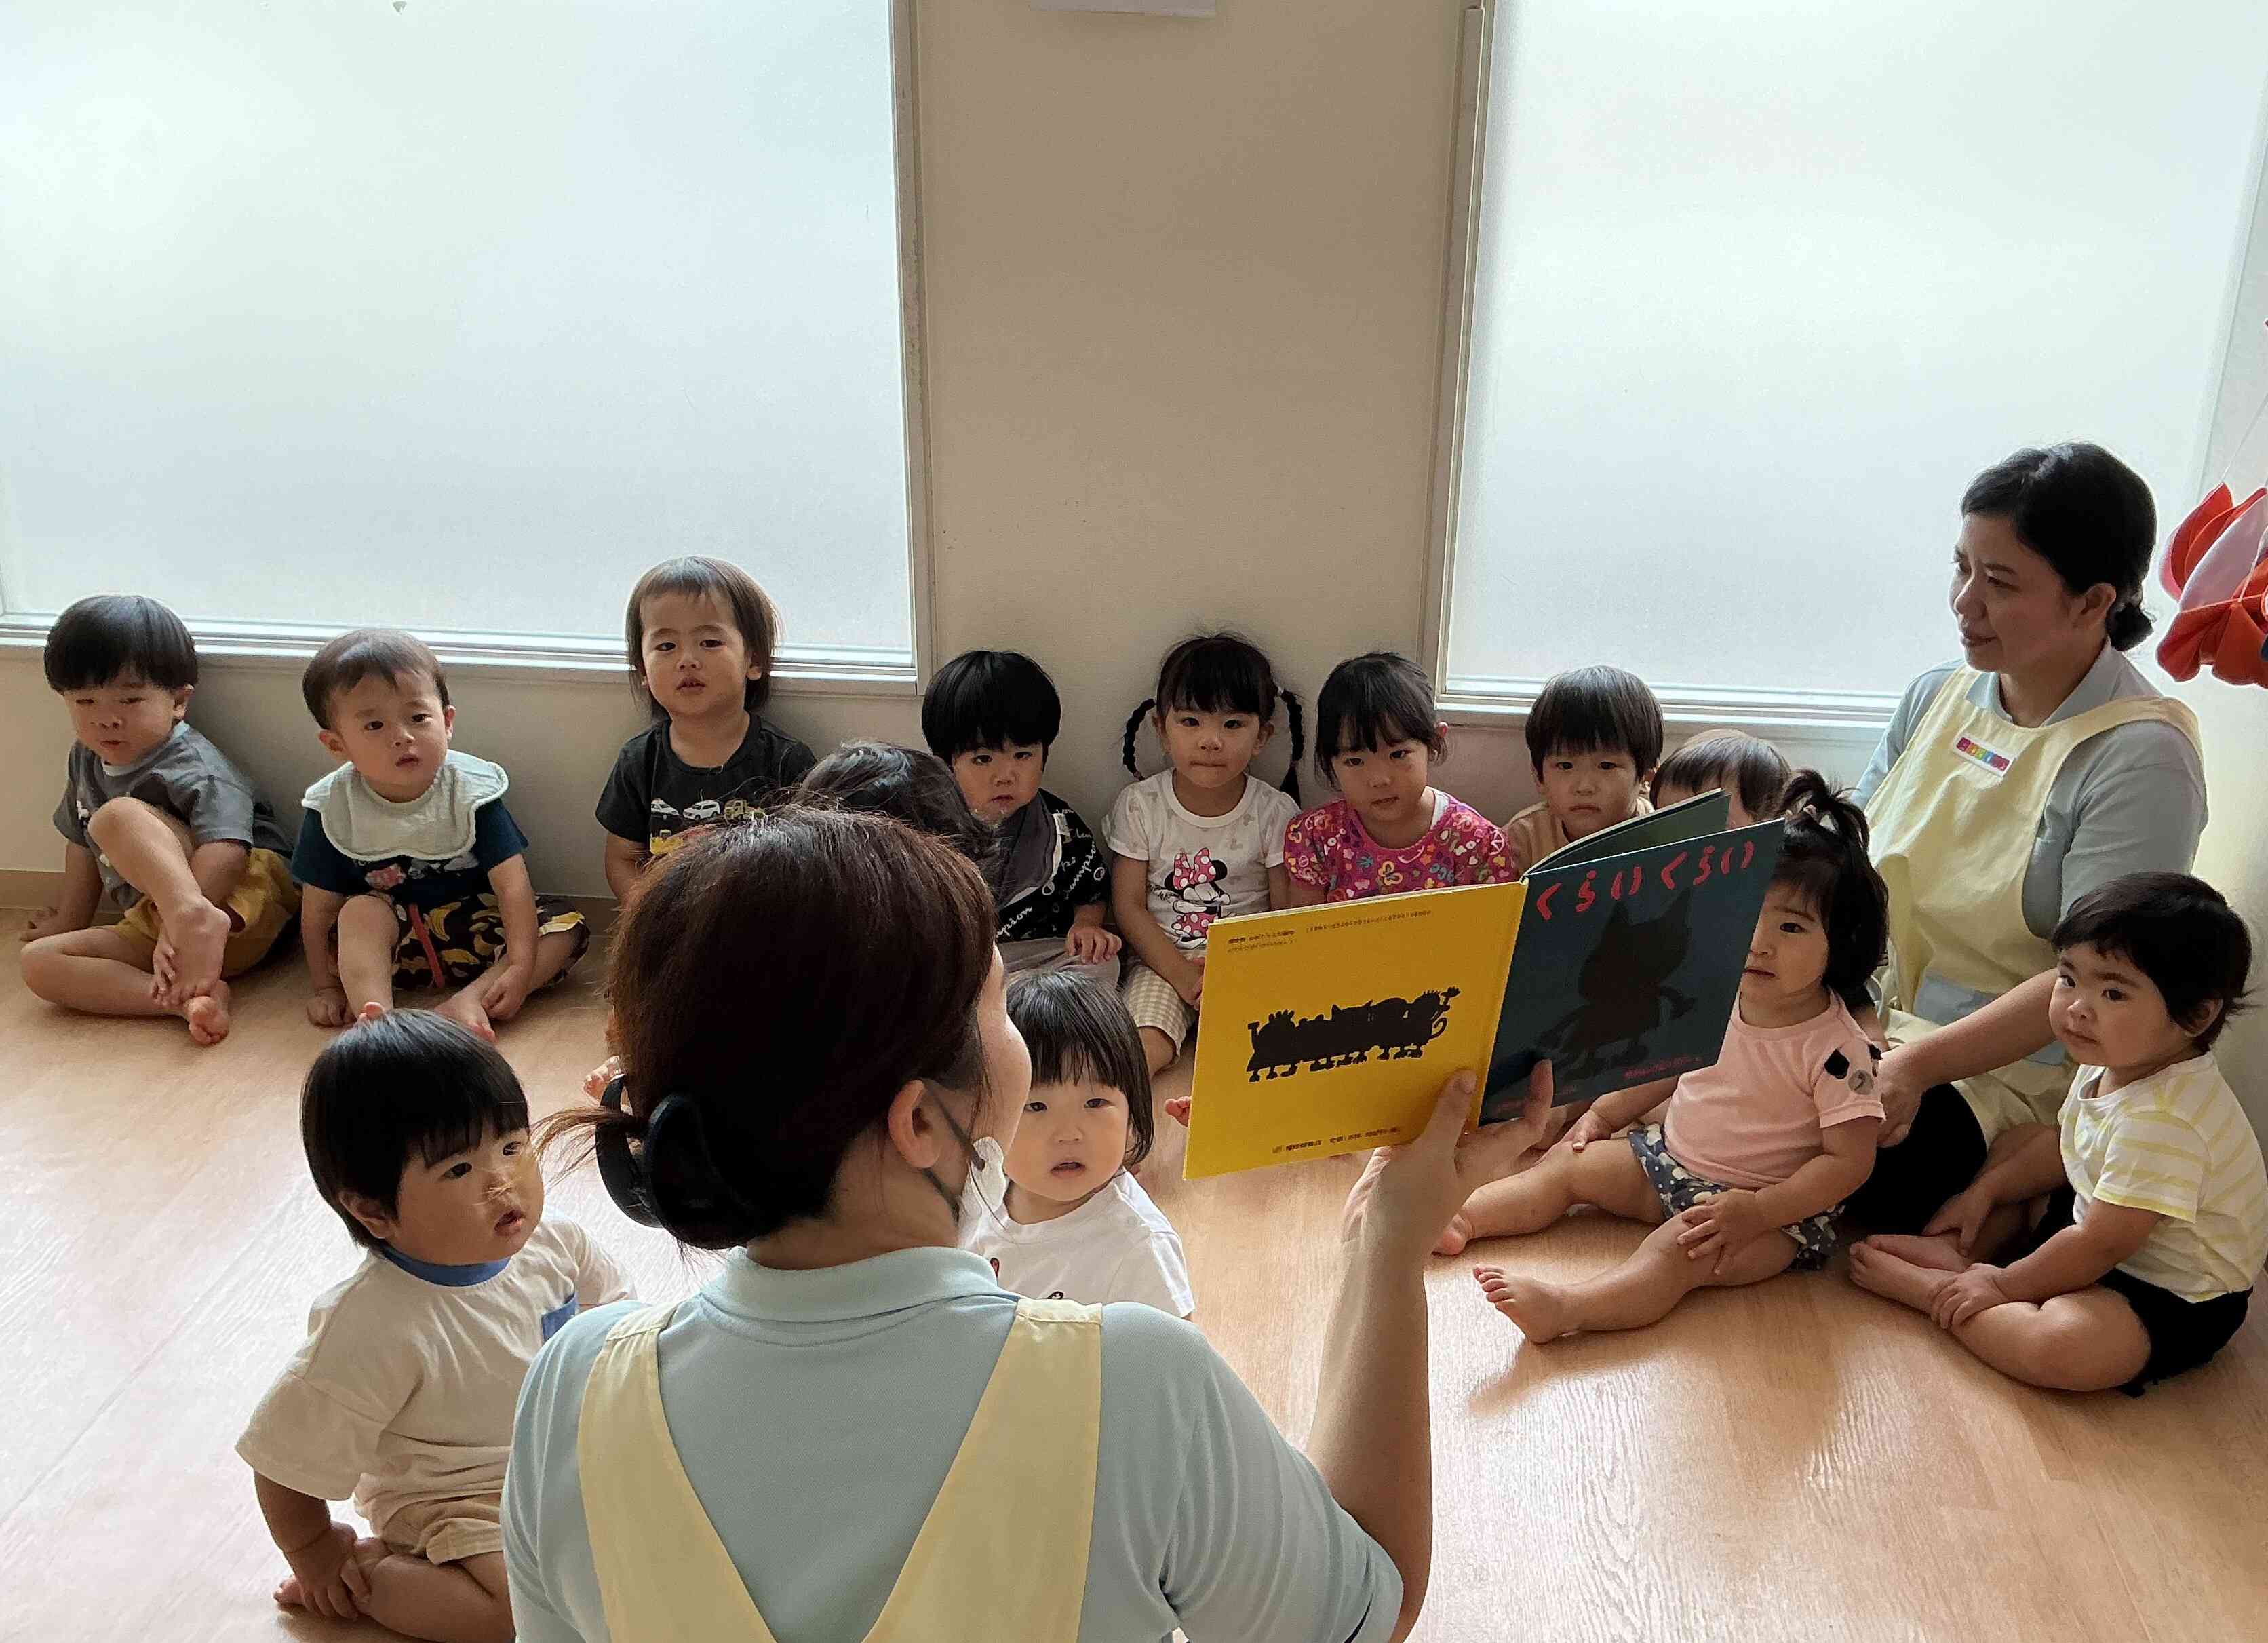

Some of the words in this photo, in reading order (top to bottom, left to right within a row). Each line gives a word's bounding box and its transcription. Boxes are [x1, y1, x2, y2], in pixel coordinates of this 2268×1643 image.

[1536, 840, 1755, 921] くらいくらい
